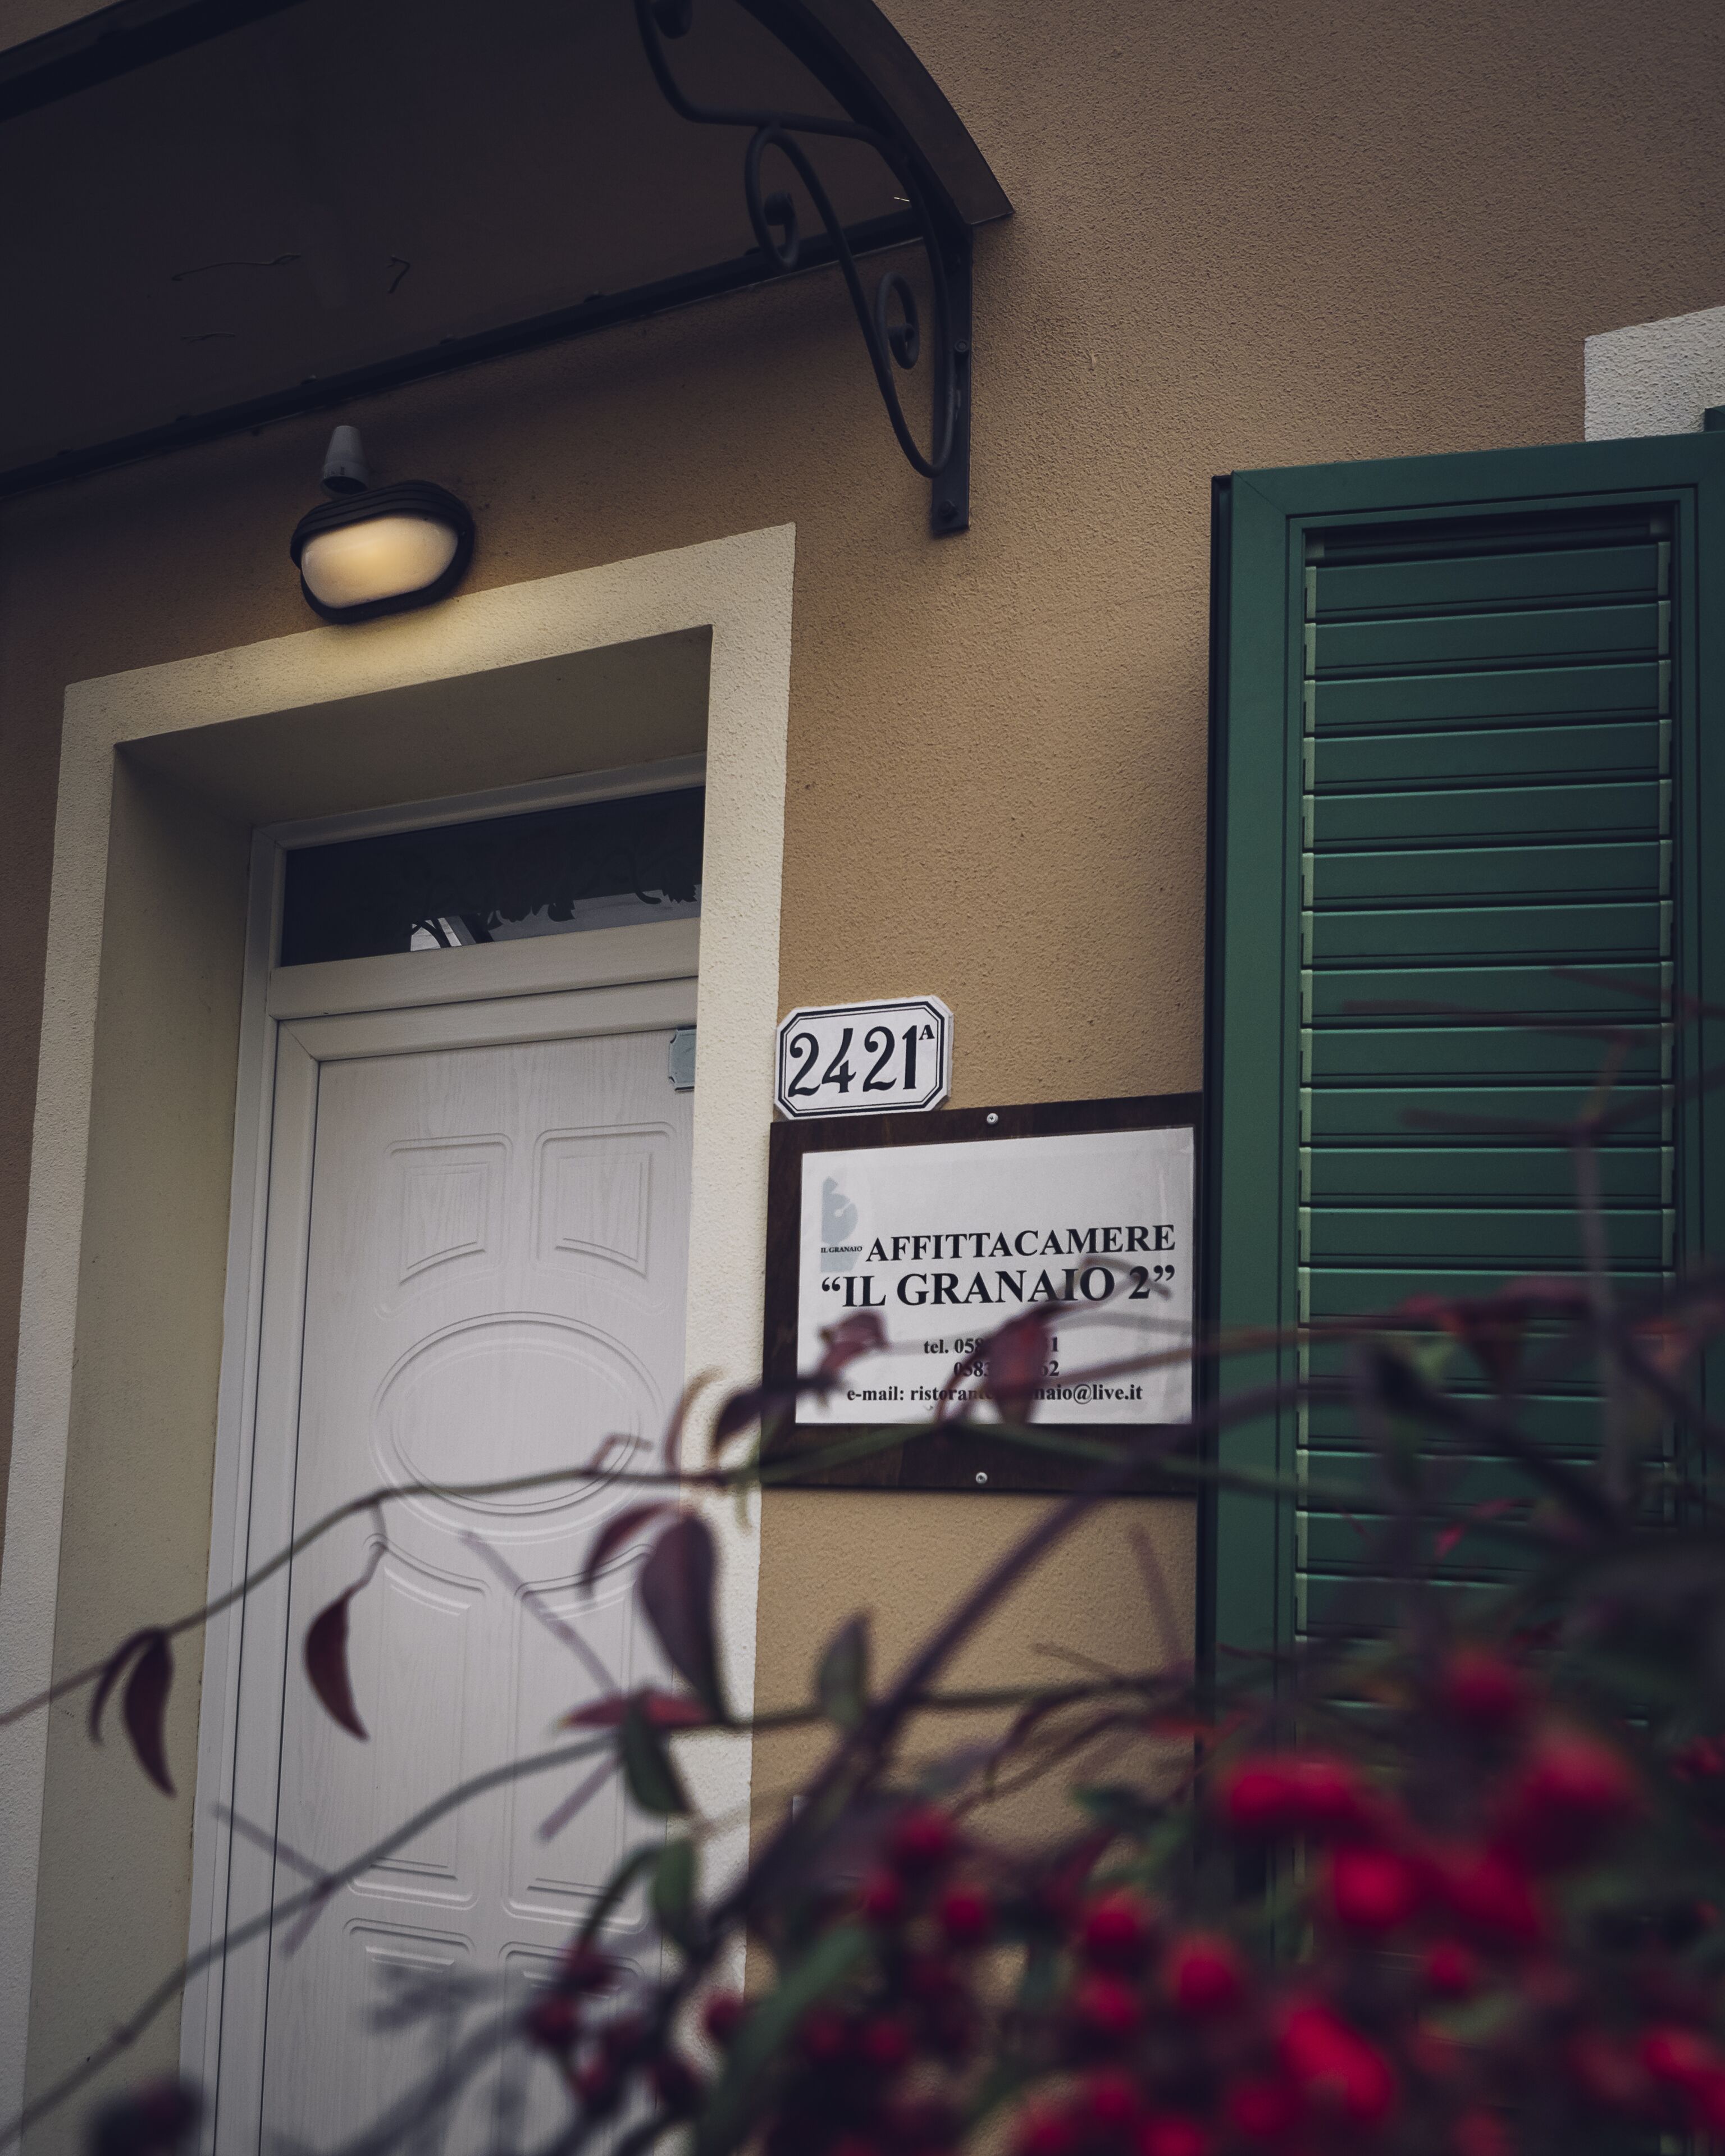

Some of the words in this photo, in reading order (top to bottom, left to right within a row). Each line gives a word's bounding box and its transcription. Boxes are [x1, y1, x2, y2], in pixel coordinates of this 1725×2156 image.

[865, 1225, 1176, 1262] AFFITTACAMERE
[897, 1266, 1115, 1307] GRANAIO
[924, 1339, 949, 1354] tel.
[847, 1386, 904, 1401] e-mail:
